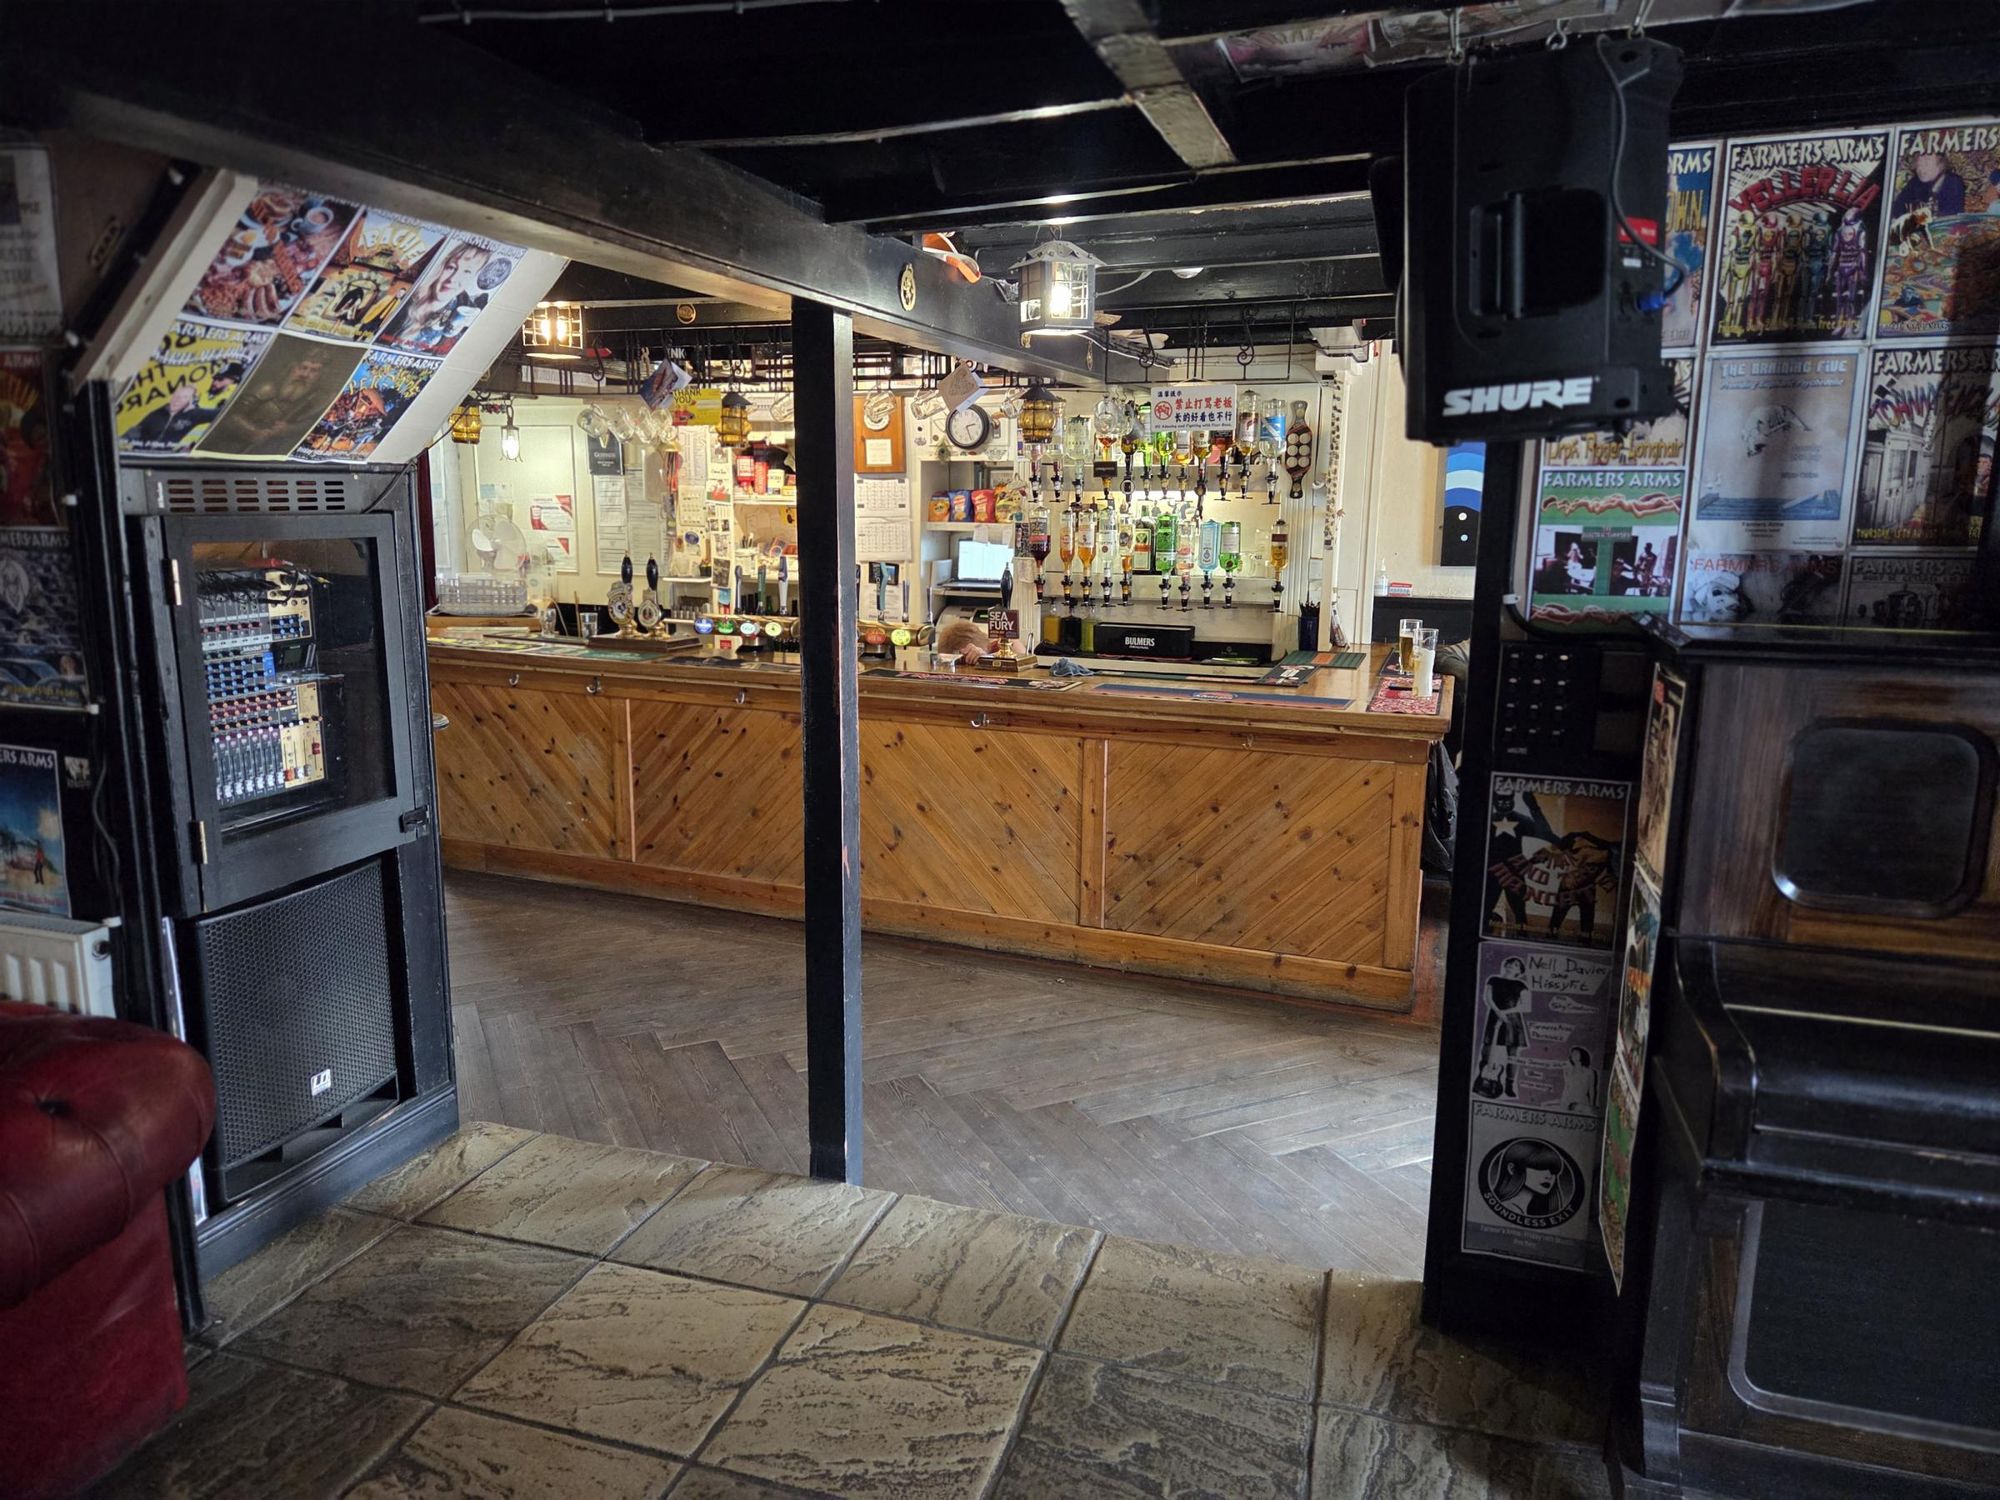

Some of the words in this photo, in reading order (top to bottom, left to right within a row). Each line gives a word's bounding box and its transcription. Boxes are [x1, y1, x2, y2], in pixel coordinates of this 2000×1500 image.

[1900, 127, 1998, 157] FARMERS
[1731, 141, 1824, 171] FARMERS
[1825, 135, 1885, 163] ARMS
[231, 330, 270, 344] ARMS
[365, 349, 412, 367] FARMERS
[413, 358, 442, 370] ARMS
[1874, 348, 1968, 375] FARMERS
[673, 388, 701, 397] THANK
[675, 395, 691, 404] YOU
[1442, 377, 1593, 416] SHURE
[1175, 411, 1233, 423] 长的好看也不行
[1544, 471, 1625, 488] FARMERS
[1629, 471, 1681, 488] ARMS
[989, 611, 1008, 621] SEA
[989, 621, 1014, 631] FURY
[1125, 636, 1155, 647] BULMERS
[19, 754, 54, 769] ARMS
[1494, 776, 1571, 795] FARMERS
[1575, 784, 1626, 800] ARMS
[1529, 956, 1557, 970] Nell
[1474, 1102, 1546, 1125] FARMERS
[1550, 1115, 1600, 1132] ARMS
[1483, 1191, 1547, 1228] SOUNDLESS
[1550, 1206, 1576, 1227] EXIT
